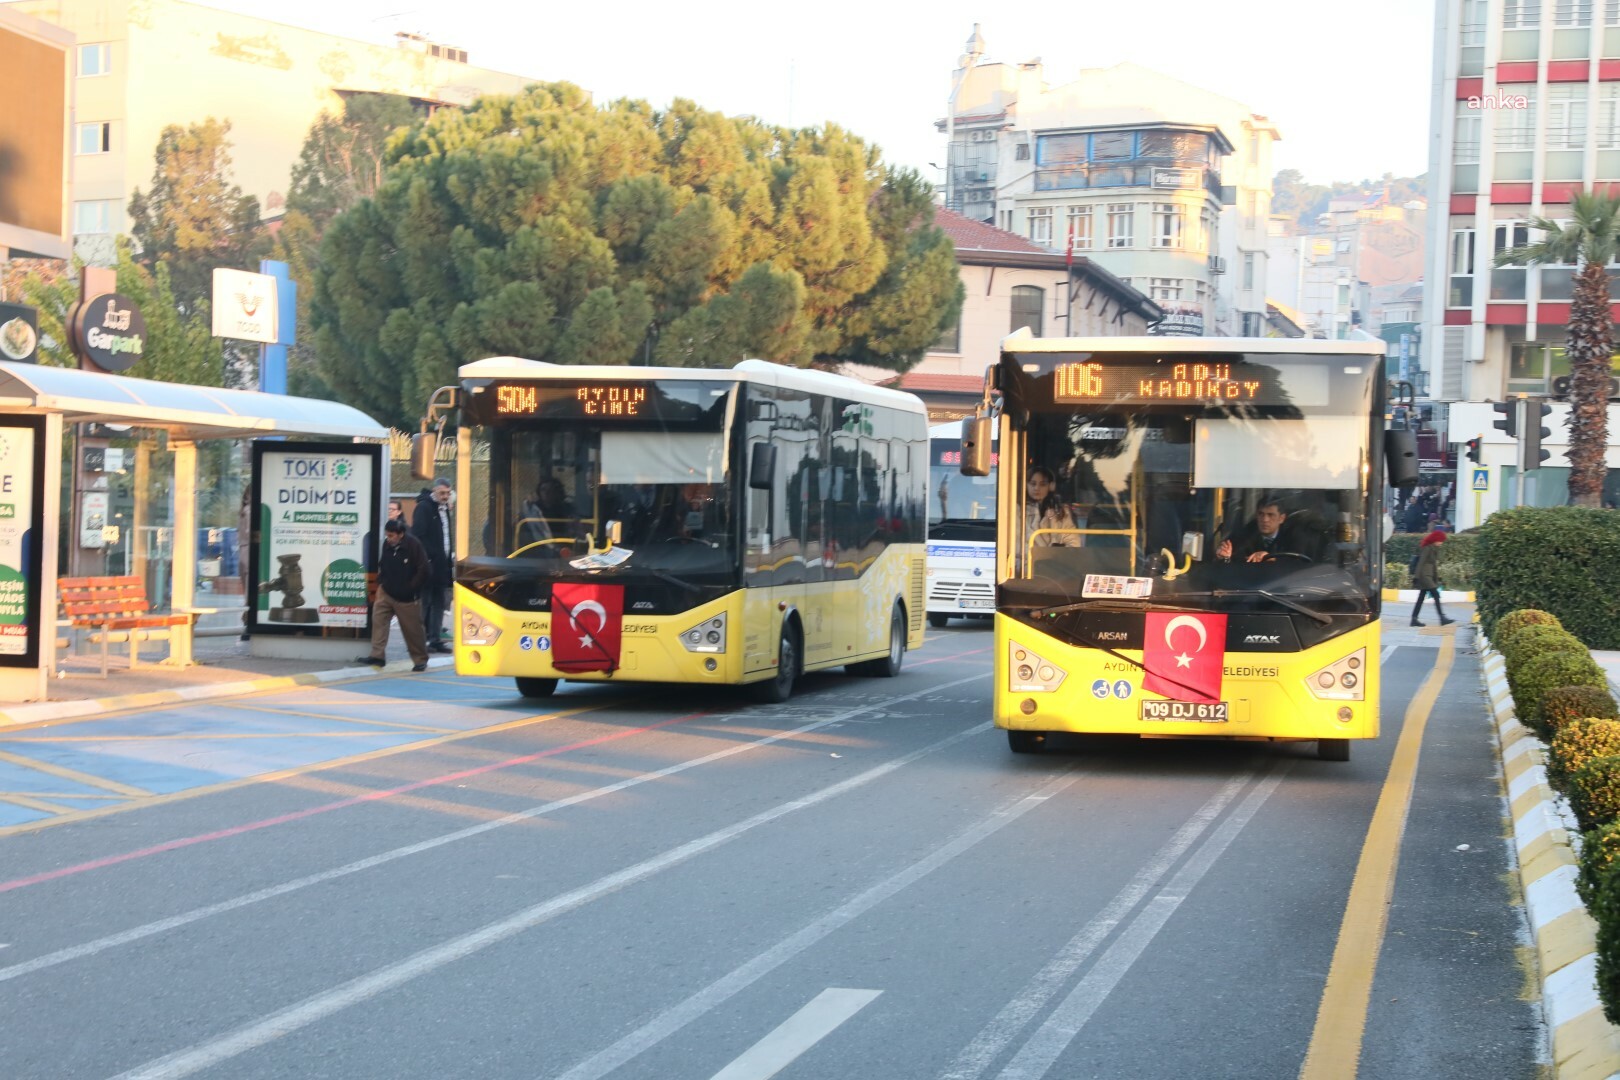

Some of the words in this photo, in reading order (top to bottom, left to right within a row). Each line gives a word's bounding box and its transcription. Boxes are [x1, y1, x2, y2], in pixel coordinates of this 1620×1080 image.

[87, 327, 143, 356] Garpark
[1055, 363, 1102, 396] 106
[1174, 364, 1229, 381] ADÜ
[577, 387, 645, 401] AYDIN
[1140, 380, 1259, 397] KADIKÖY
[283, 459, 326, 477] TOKİ
[278, 486, 357, 505] DİDİM'DE
[282, 509, 291, 521] 4
[335, 514, 357, 523] ARSA
[631, 601, 656, 609] ATA
[521, 621, 549, 630] AYDIN
[621, 623, 658, 634] LEDİYESİ
[1242, 634, 1281, 644] ATAK
[1103, 662, 1137, 673] AYDIN
[1223, 666, 1280, 677] ELEDİYESİ
[1150, 703, 1169, 717] 09
[1172, 703, 1195, 718] DJ
[1197, 704, 1226, 718] 612
